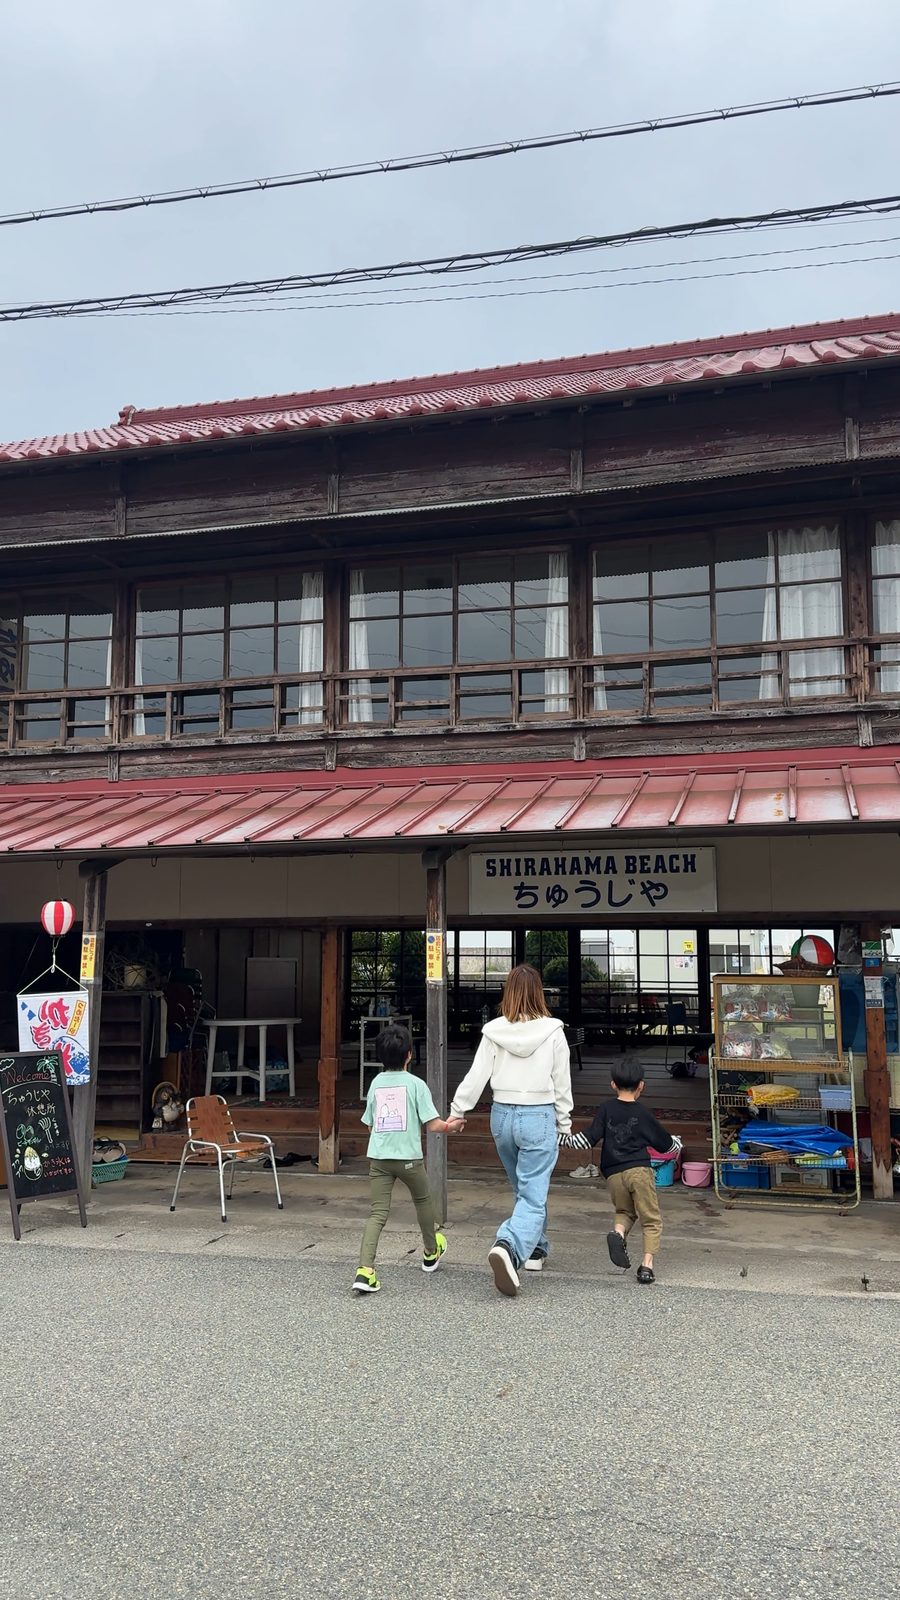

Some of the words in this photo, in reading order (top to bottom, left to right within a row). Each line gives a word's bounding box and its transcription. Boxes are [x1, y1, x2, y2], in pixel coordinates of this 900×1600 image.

[486, 855, 618, 877] SHIRAHAMA
[624, 854, 697, 875] BEACH
[513, 878, 669, 908] ちゅうじや
[2, 1066, 50, 1084] Welcome
